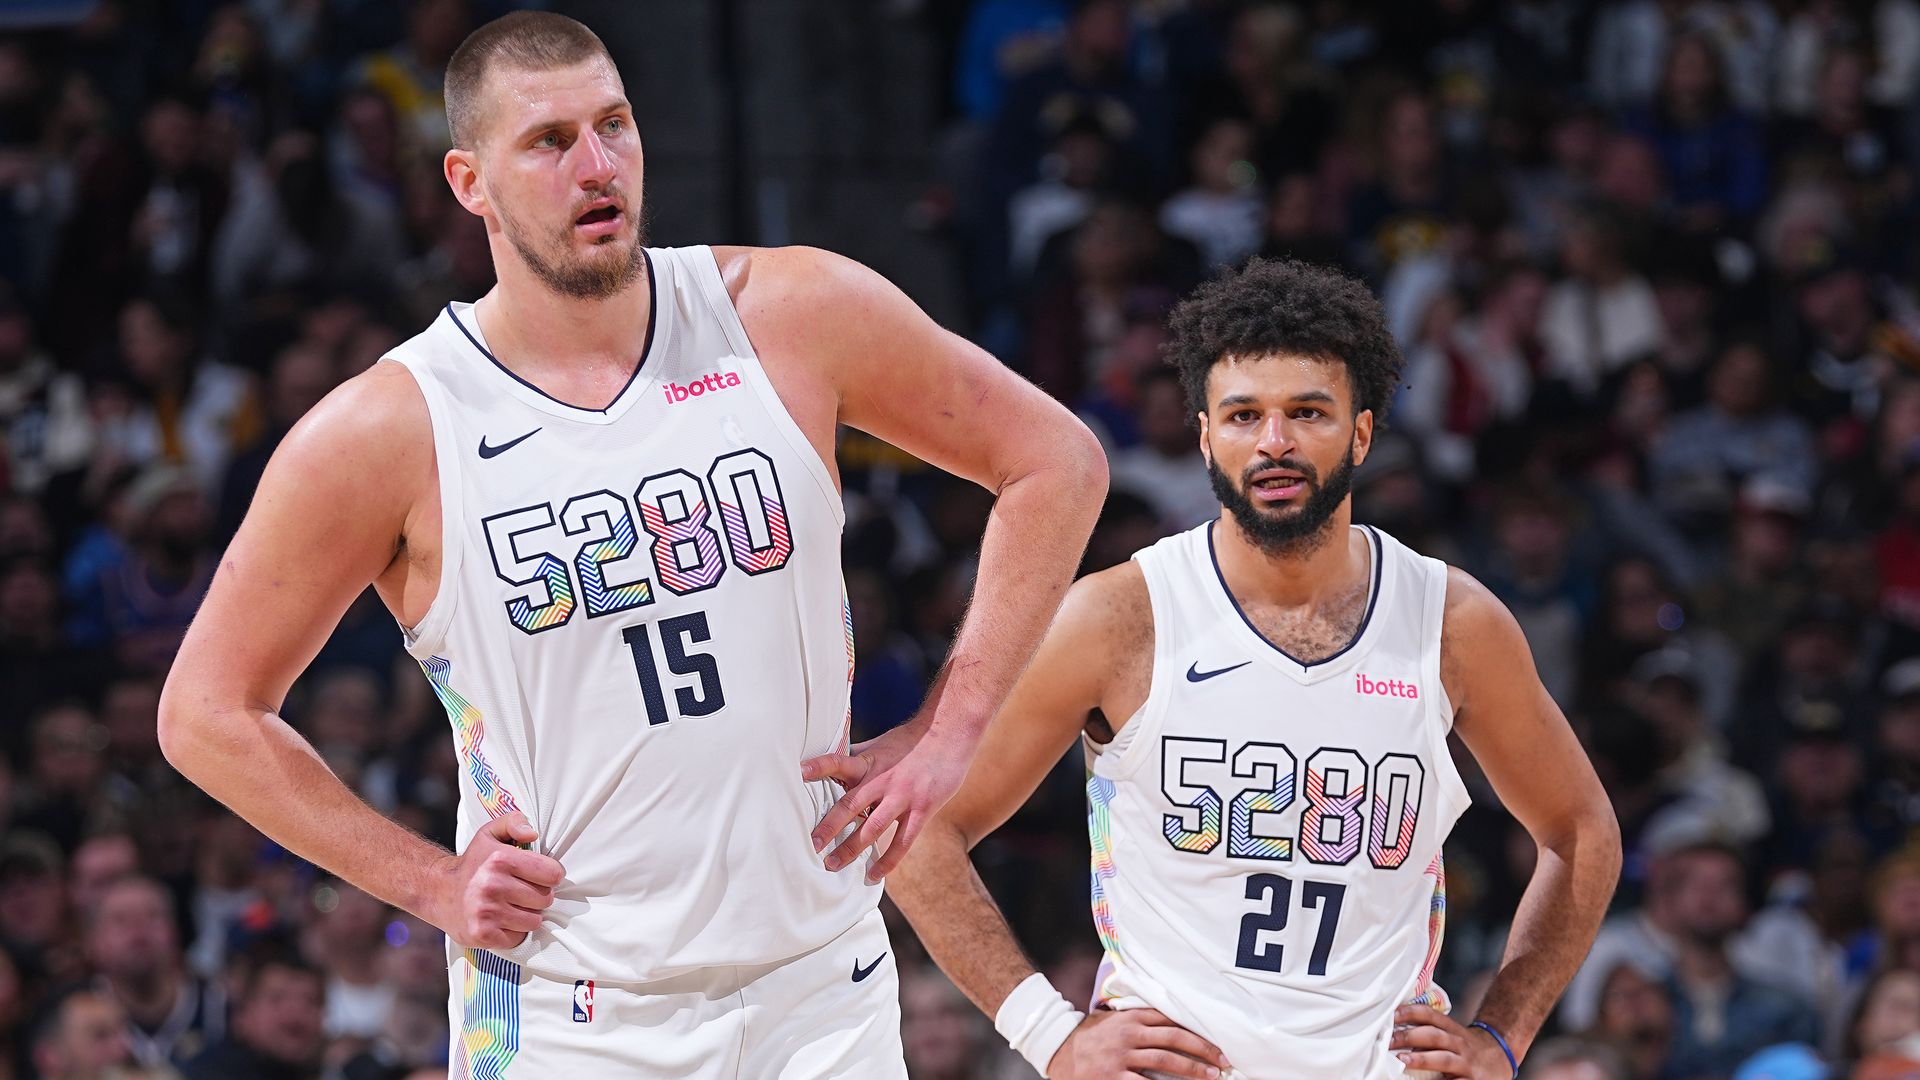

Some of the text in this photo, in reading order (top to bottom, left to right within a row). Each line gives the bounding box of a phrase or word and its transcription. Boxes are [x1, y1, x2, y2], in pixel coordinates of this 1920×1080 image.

[663, 370, 741, 404] ibotta
[481, 447, 794, 635] 5280
[622, 610, 727, 727] 15
[1356, 673, 1419, 699] ibotta
[1161, 735, 1425, 870] 5280
[1235, 872, 1348, 976] 27
